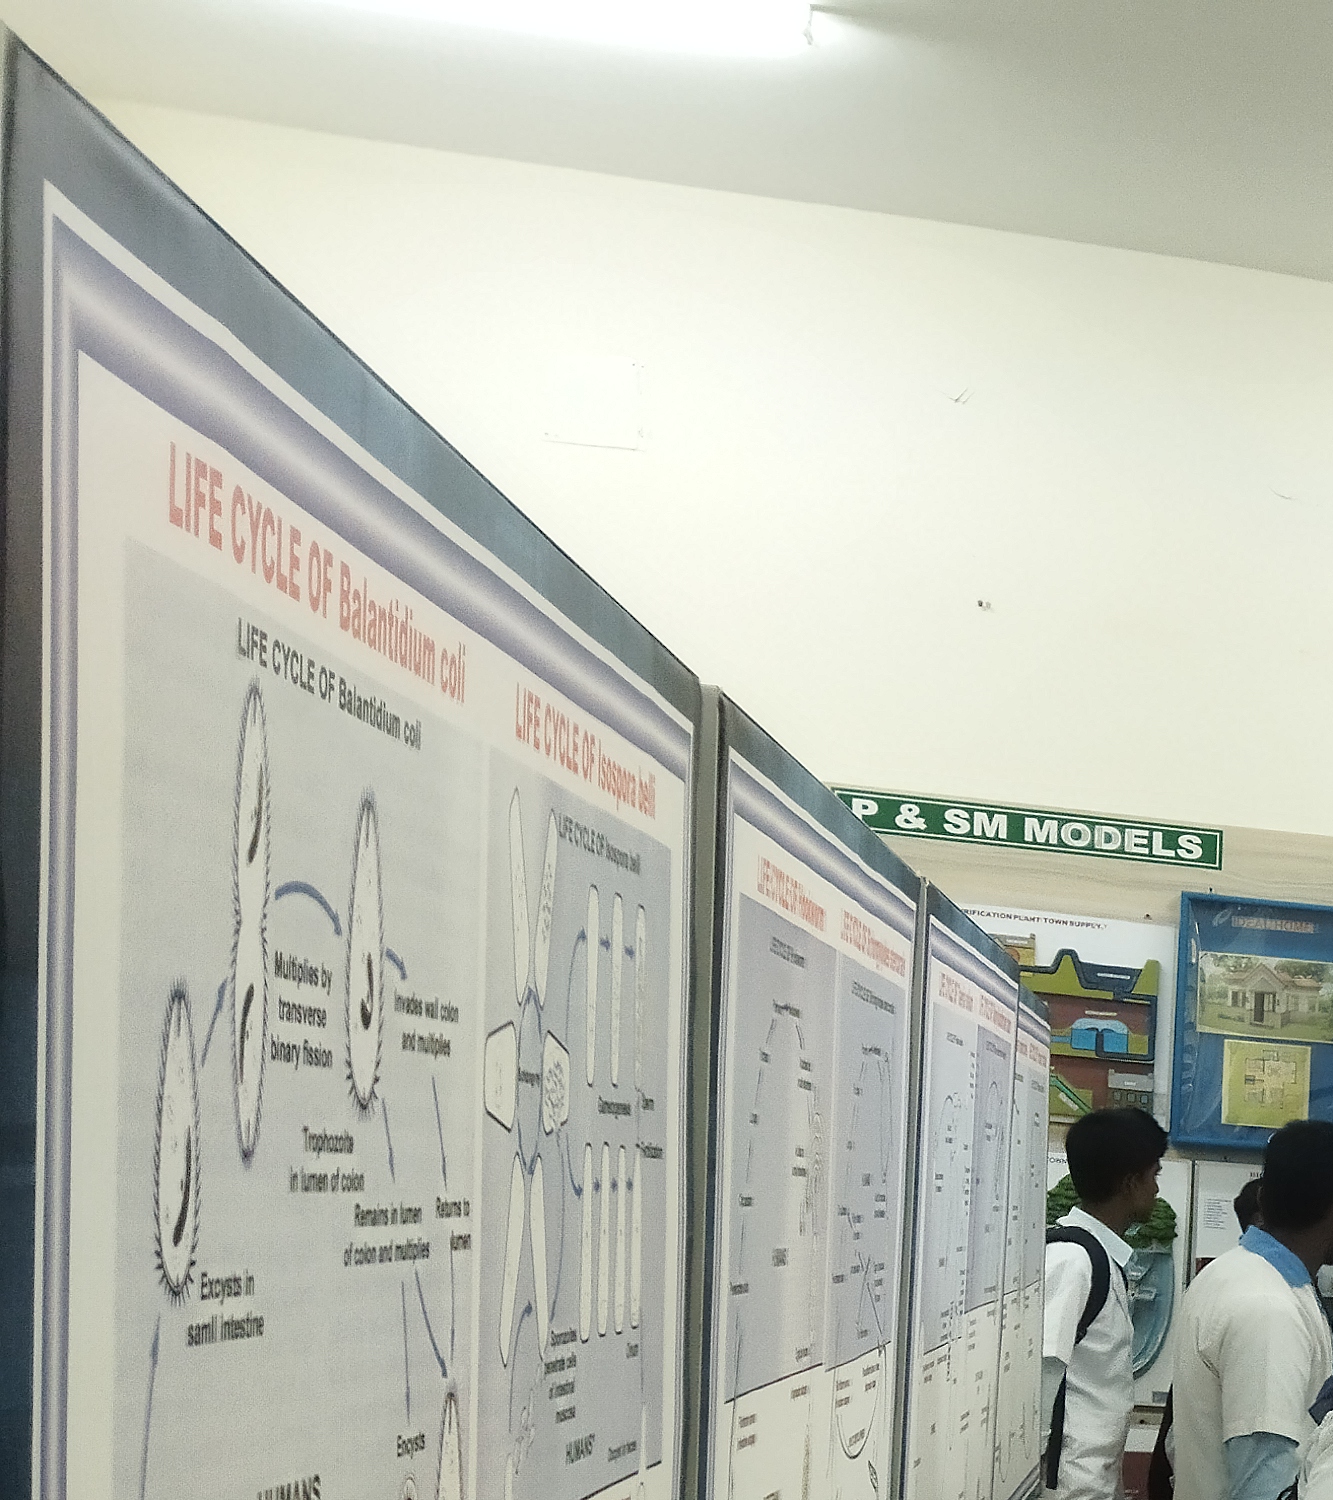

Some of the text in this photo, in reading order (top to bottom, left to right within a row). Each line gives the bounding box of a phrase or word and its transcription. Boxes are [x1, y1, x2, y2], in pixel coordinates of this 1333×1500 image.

[169, 441, 466, 704] LIFE CYCLE OF Balantidium coli
[238, 617, 421, 750] LIFE CYCLE OF Balantidium coli
[516, 682, 540, 750] LIFE
[544, 703, 579, 775] CYCLE
[582, 729, 595, 783] OF
[598, 738, 636, 811] Isospora
[851, 797, 1203, 859] P & SM MODELS
[962, 908, 1012, 920] RIFICATION
[1044, 918, 1068, 926] TOWN
[274, 951, 332, 996] Multiplies by
[279, 996, 327, 1028] transverse
[425, 997, 439, 1019] wall
[441, 1000, 458, 1023] colon
[270, 1034, 332, 1070] binary fission
[402, 1031, 415, 1051] and
[302, 1126, 354, 1158] Trophozoite
[291, 1167, 364, 1192] in lumen of colon
[354, 1203, 388, 1227] Remains
[391, 1202, 397, 1225] in
[464, 1199, 470, 1217] to
[344, 1241, 430, 1267] of colon and multiplies
[201, 1269, 254, 1305] Excysts in
[221, 1310, 264, 1341] intestine
[397, 1432, 425, 1459] Encysts
